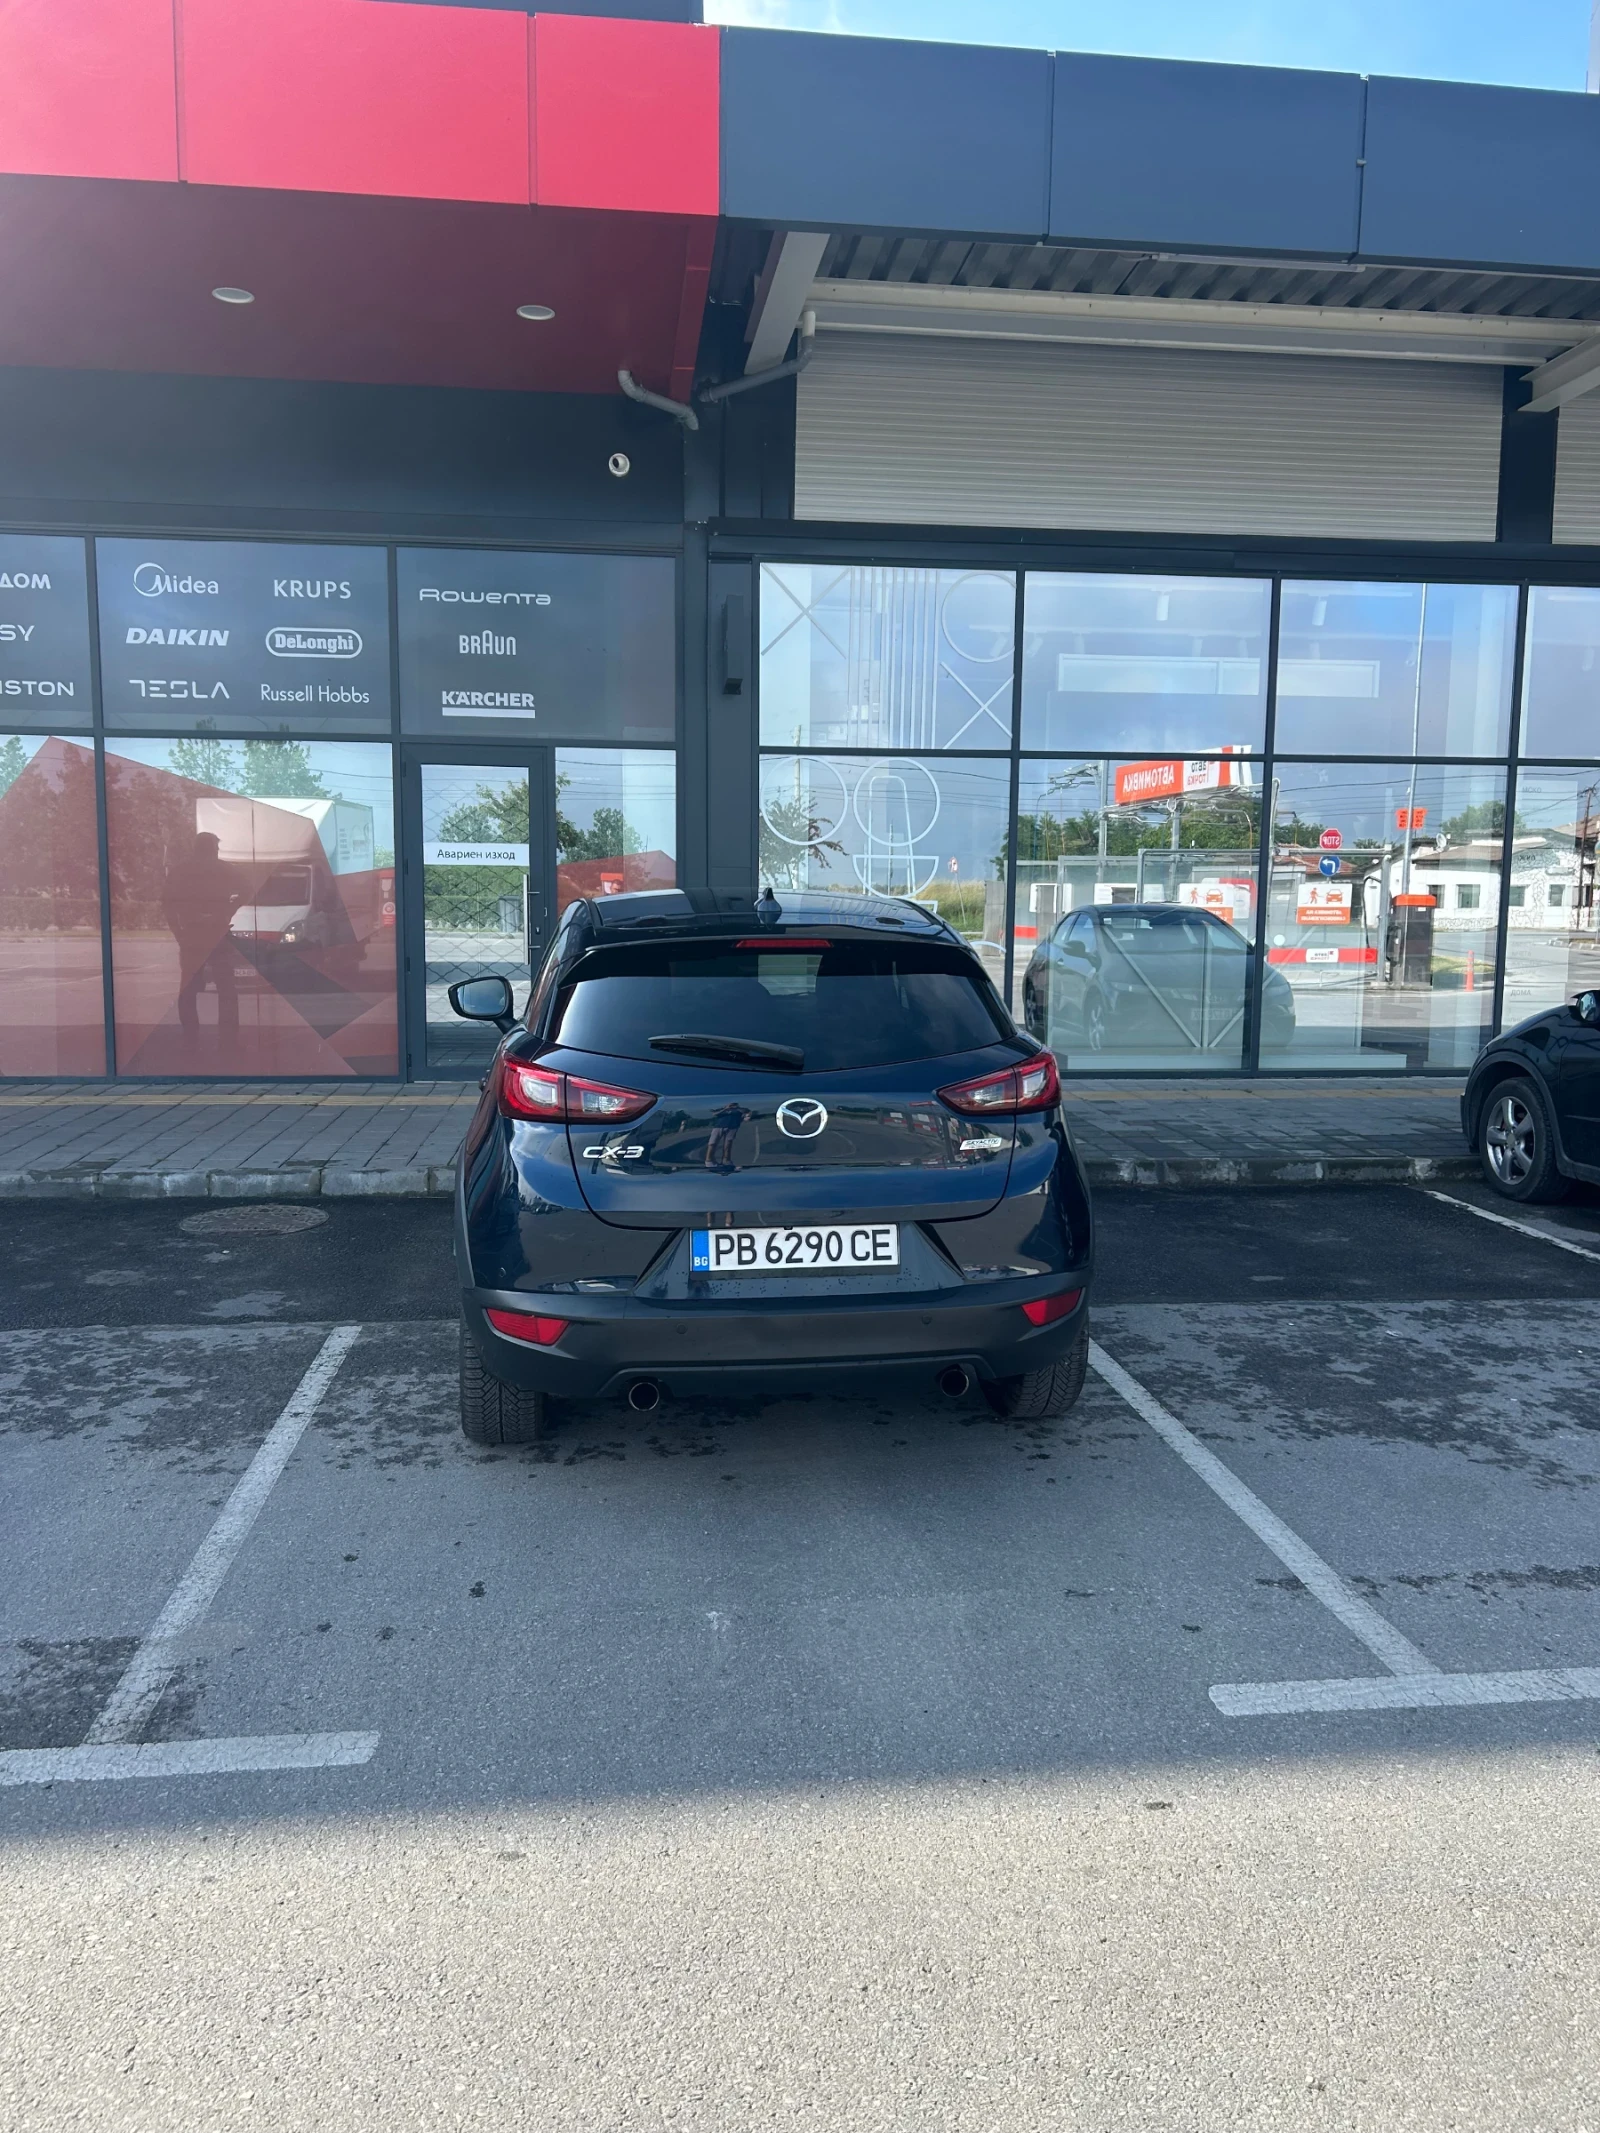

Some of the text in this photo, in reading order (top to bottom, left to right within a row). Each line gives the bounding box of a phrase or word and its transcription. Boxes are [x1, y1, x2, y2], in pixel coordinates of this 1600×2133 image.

[142, 569, 219, 597] Midea
[274, 580, 352, 599] KRUPS
[126, 627, 230, 646] DAIKIN
[459, 630, 517, 656] BRAUN
[129, 679, 230, 699] TESLA
[260, 684, 370, 703] Russell Hobbs
[442, 690, 535, 708] KÄRCHER
[437, 849, 516, 861] Авариен изход
[582, 1145, 645, 1159] CX-3
[715, 1229, 892, 1266] PB 6290 CE
[693, 1256, 709, 1267] BG
